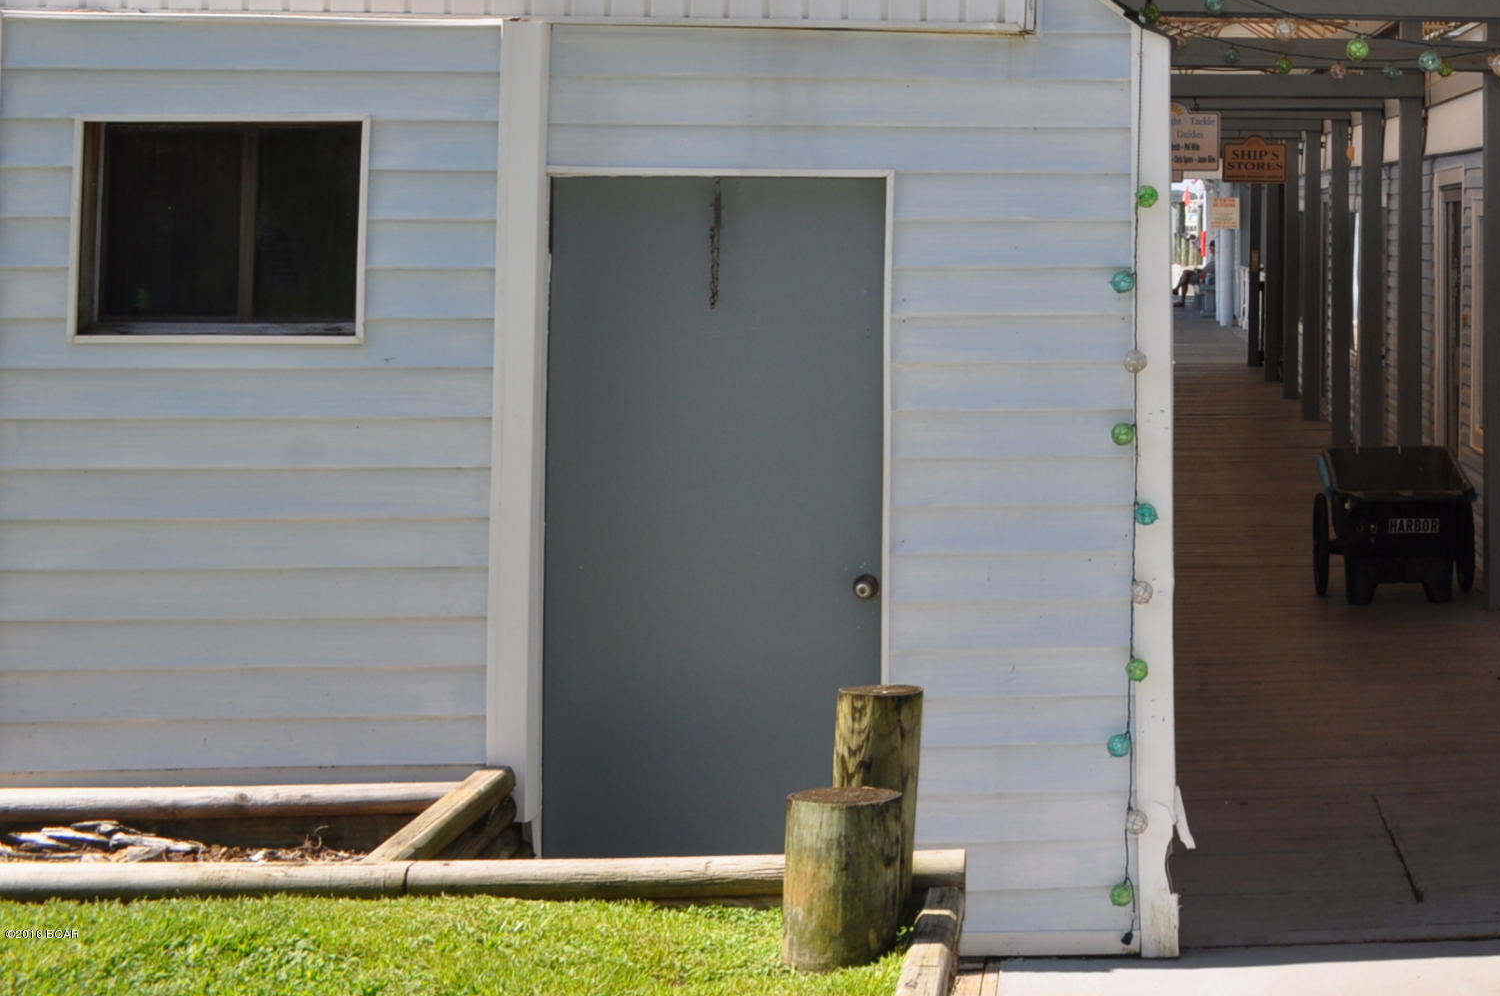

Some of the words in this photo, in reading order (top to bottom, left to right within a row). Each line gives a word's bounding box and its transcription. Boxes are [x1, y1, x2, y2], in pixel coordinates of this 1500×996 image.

[1189, 115, 1216, 126] Tackle
[1176, 130, 1204, 140] Guides
[1231, 149, 1280, 161] SHIP'S
[1227, 161, 1283, 171] STORES
[1389, 517, 1439, 533] HARBOR
